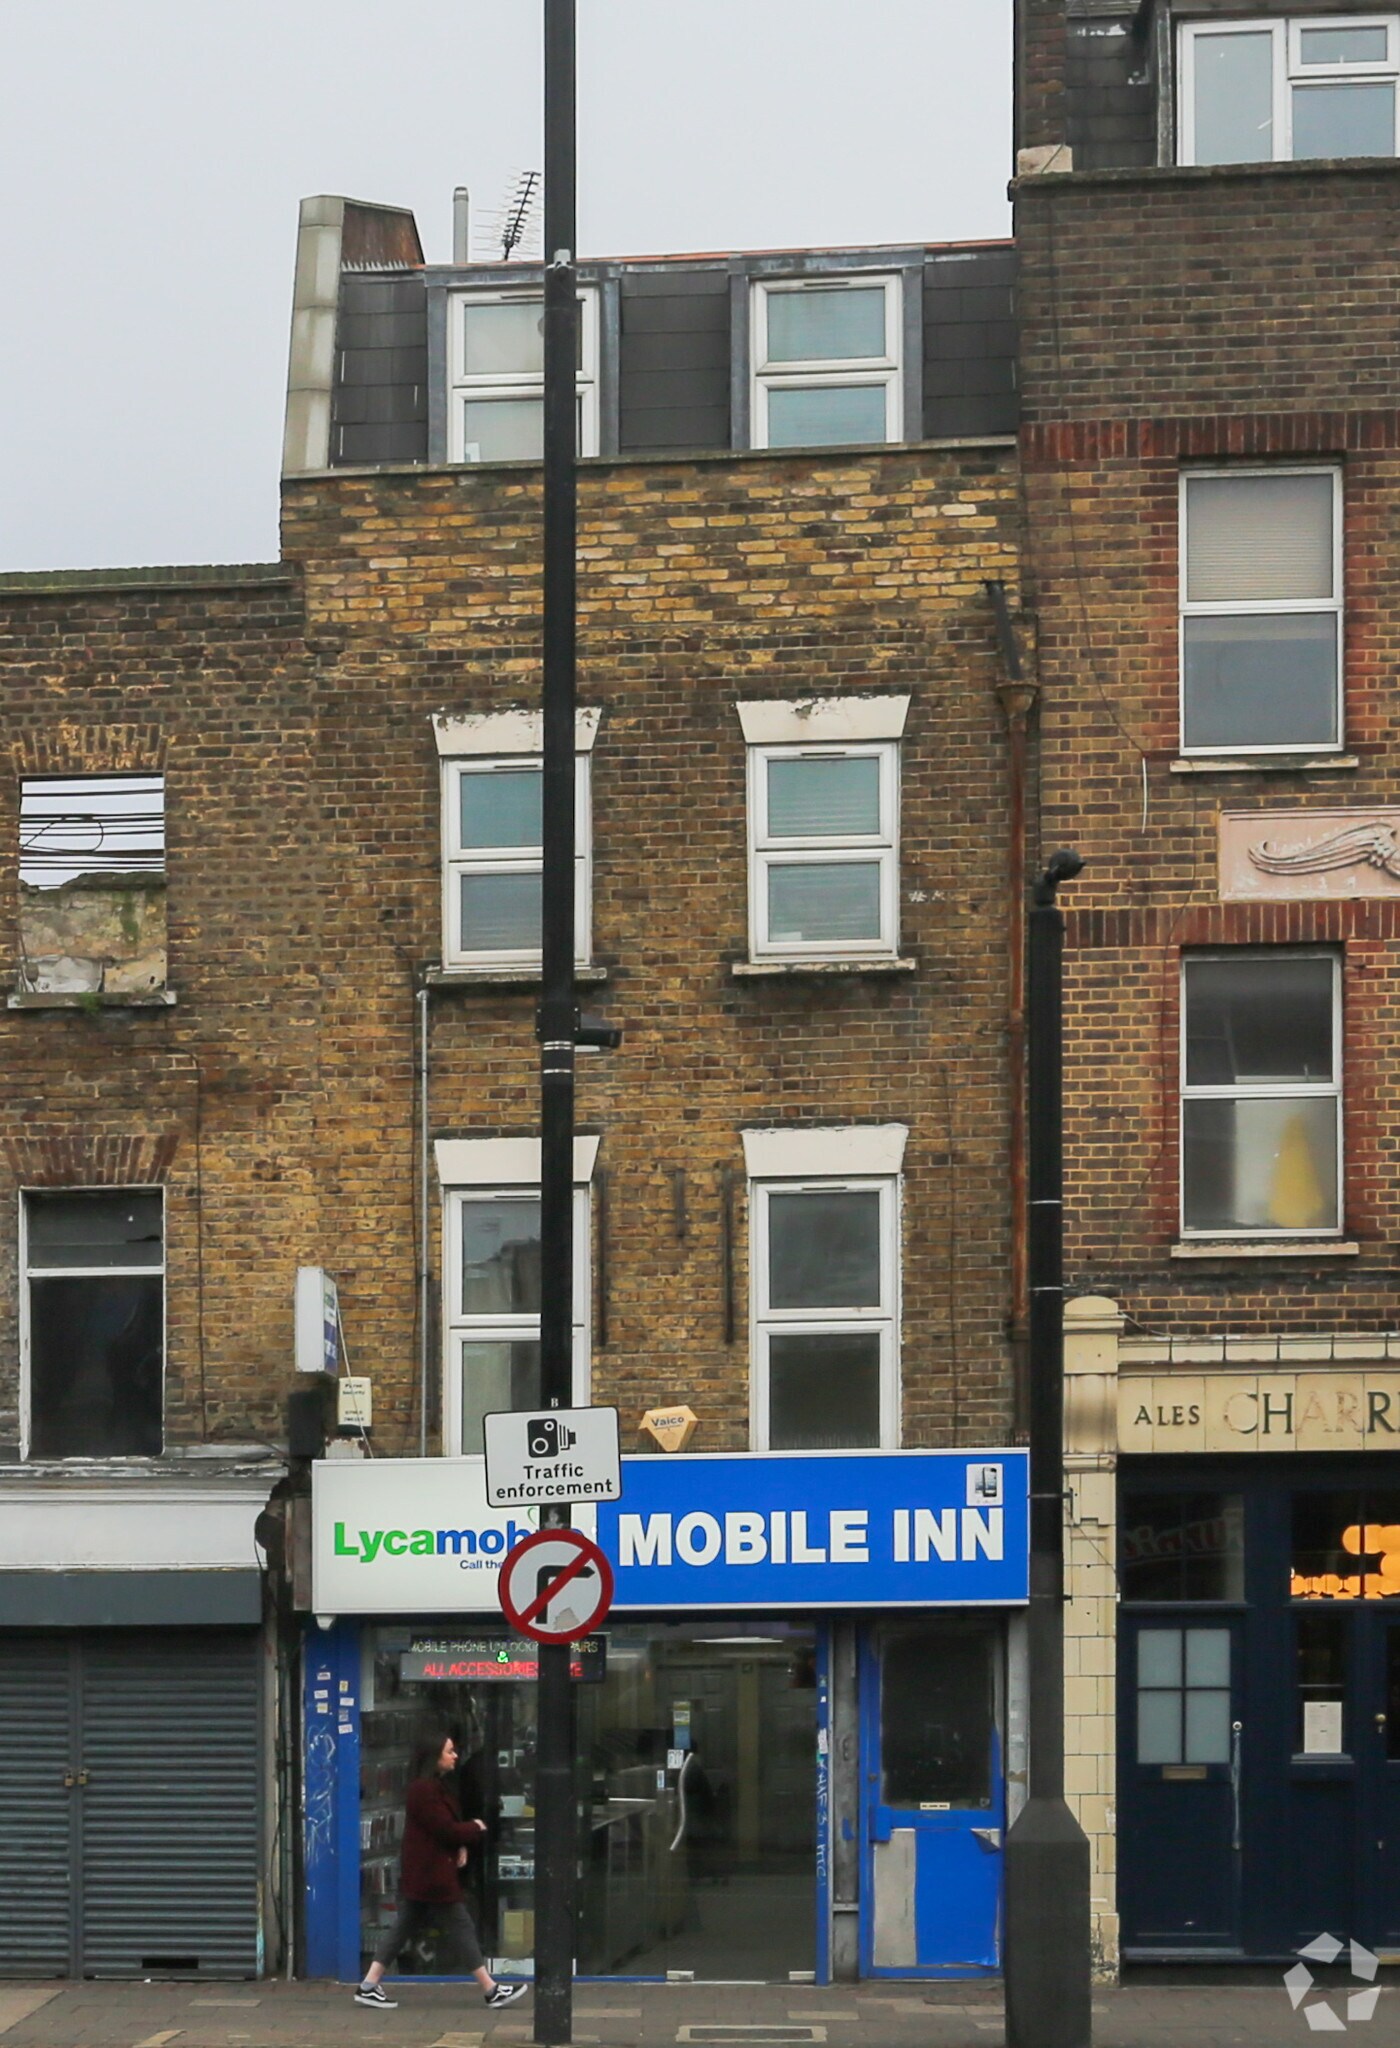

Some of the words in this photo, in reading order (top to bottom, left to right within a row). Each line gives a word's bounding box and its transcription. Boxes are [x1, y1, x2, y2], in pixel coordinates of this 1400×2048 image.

[651, 1416, 684, 1427] Vaico
[1133, 1405, 1200, 1426] ALES
[1224, 1391, 1400, 1434] CHARR
[523, 1463, 583, 1479] Traffic
[496, 1479, 613, 1498] enforcement
[334, 1521, 583, 1563] Lycamob
[618, 1510, 869, 1567] MOBILE
[894, 1508, 1004, 1562] INN
[460, 1560, 482, 1569] Call
